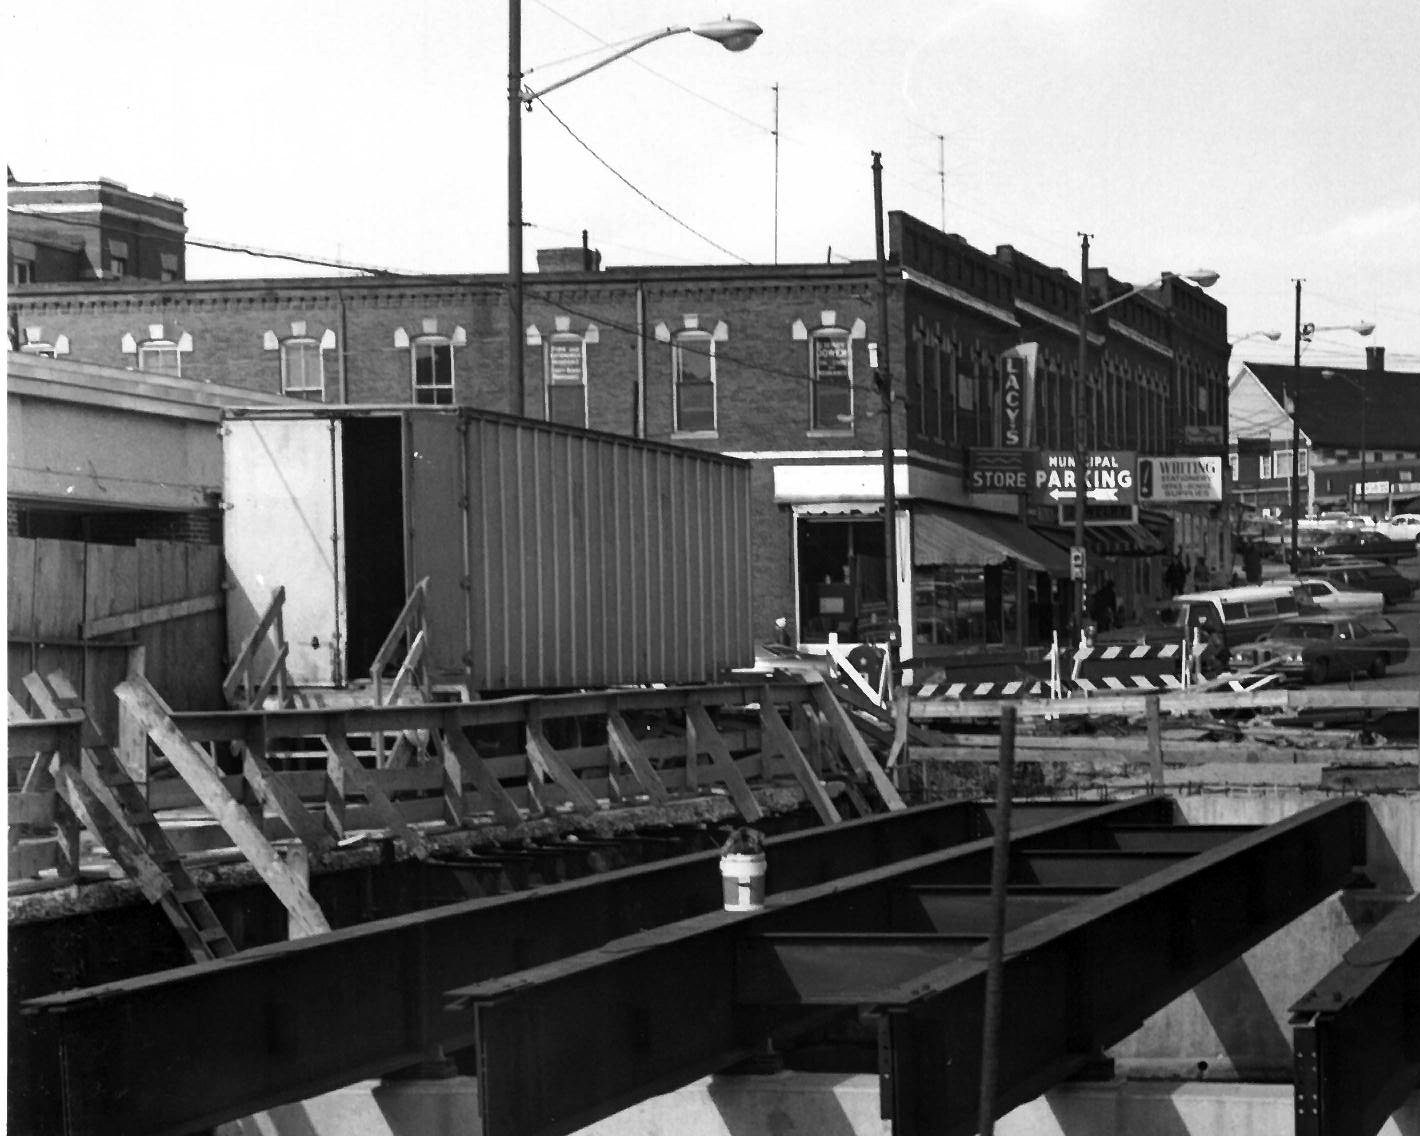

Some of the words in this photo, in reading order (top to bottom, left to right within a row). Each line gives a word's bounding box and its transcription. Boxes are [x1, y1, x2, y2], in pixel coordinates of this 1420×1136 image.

[1048, 456, 1119, 468] MUNIPAL
[1160, 461, 1216, 474] WHITING
[973, 472, 1027, 487] STORE
